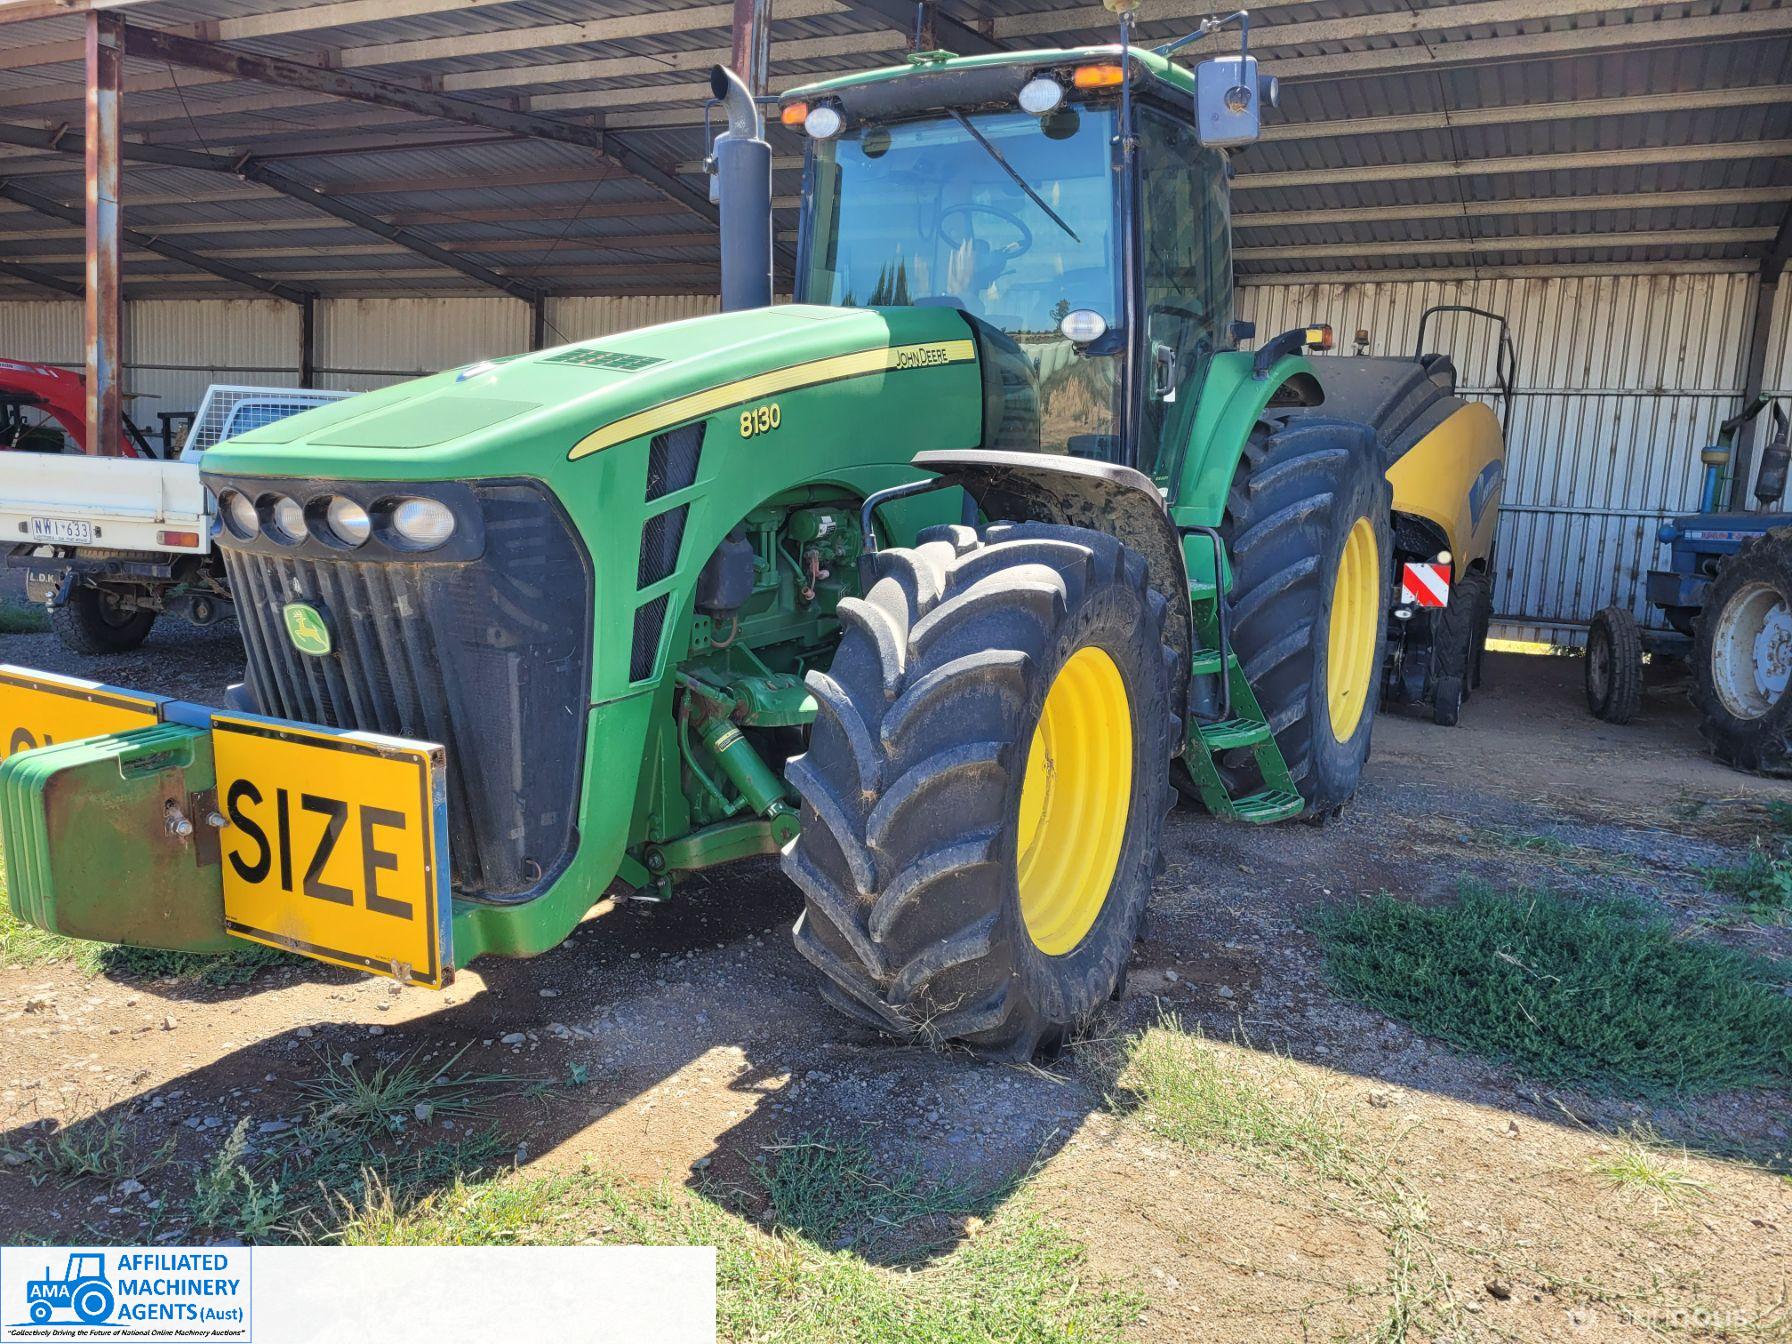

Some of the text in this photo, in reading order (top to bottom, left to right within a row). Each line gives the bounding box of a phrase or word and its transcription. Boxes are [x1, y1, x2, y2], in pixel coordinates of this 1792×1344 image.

[896, 347, 949, 367] JOHN DEERE
[739, 402, 781, 438] 8130
[66, 522, 88, 538] 633
[228, 778, 414, 921] SIZE
